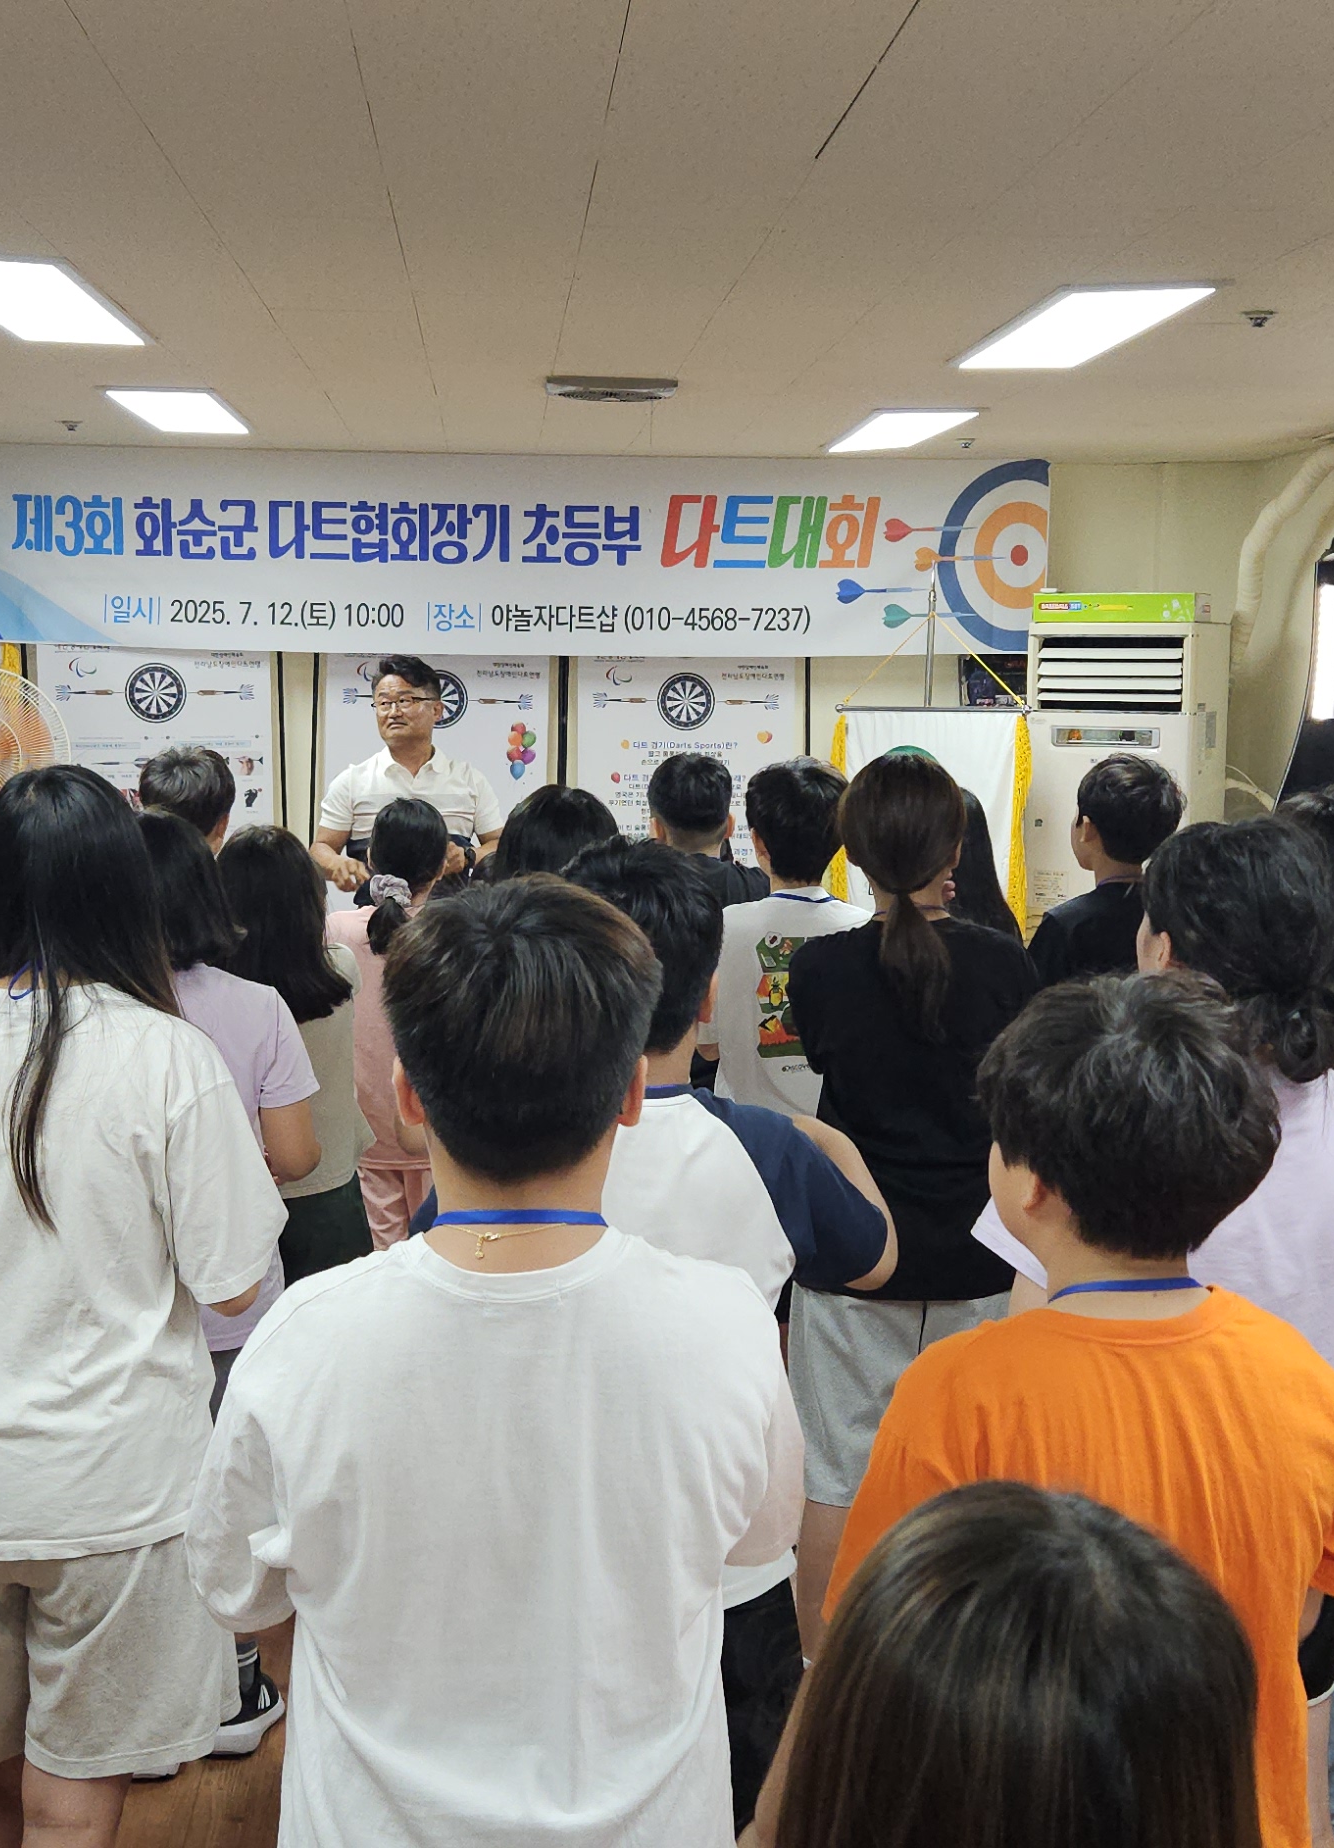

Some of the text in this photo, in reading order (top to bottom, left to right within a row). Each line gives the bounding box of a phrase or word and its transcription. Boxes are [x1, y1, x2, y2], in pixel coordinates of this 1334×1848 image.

[11, 493, 882, 570] 제3회 화순군 다트협회장기 초등부 다트대회
[110, 596, 404, 631] 일시 2025. 7. 12.(토) 10:00
[433, 603, 812, 635] 장소 야놀자다트샵 (010-4568-7237)
